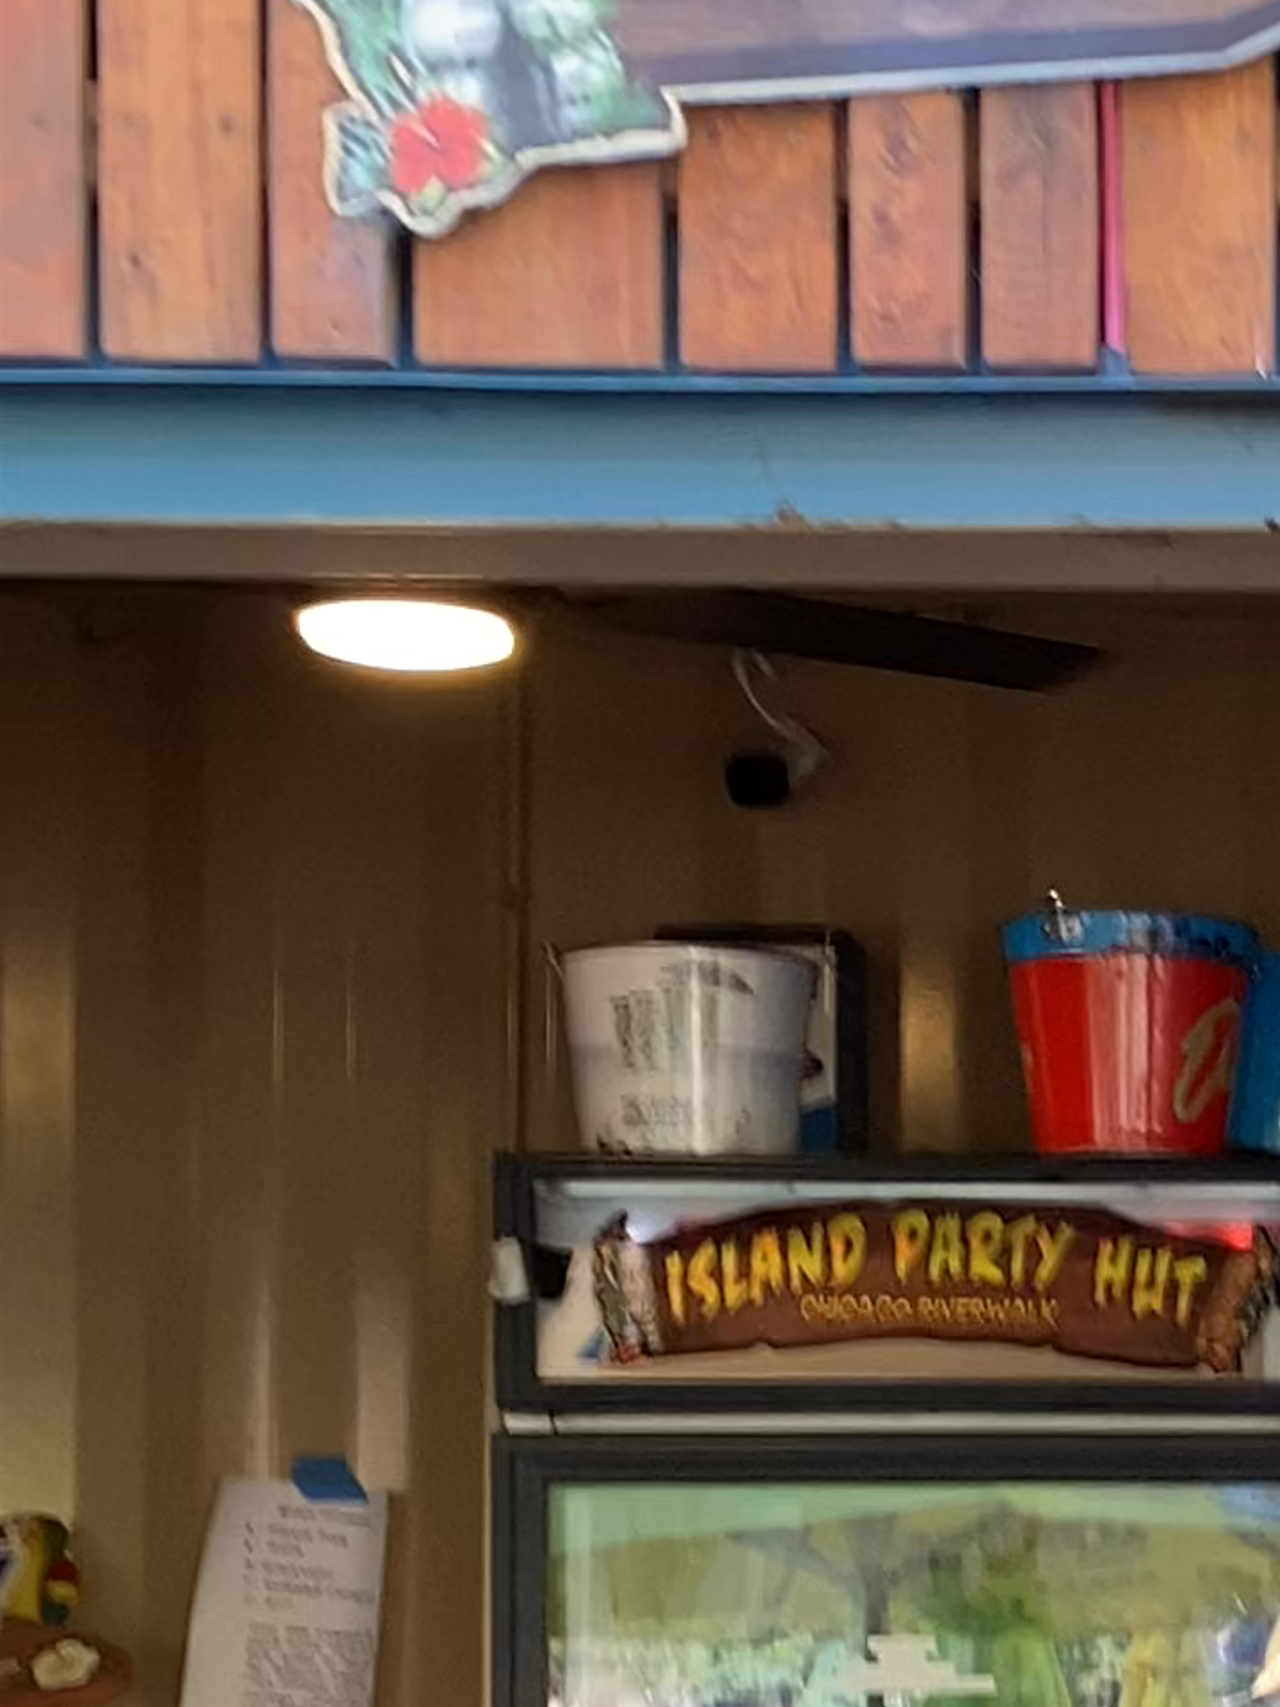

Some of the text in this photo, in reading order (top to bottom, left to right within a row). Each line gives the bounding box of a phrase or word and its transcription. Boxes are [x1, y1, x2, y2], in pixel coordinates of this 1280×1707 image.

[663, 1208, 1208, 1330] ISLAND PARTY HUT
[800, 1293, 912, 1326] CHICAGO
